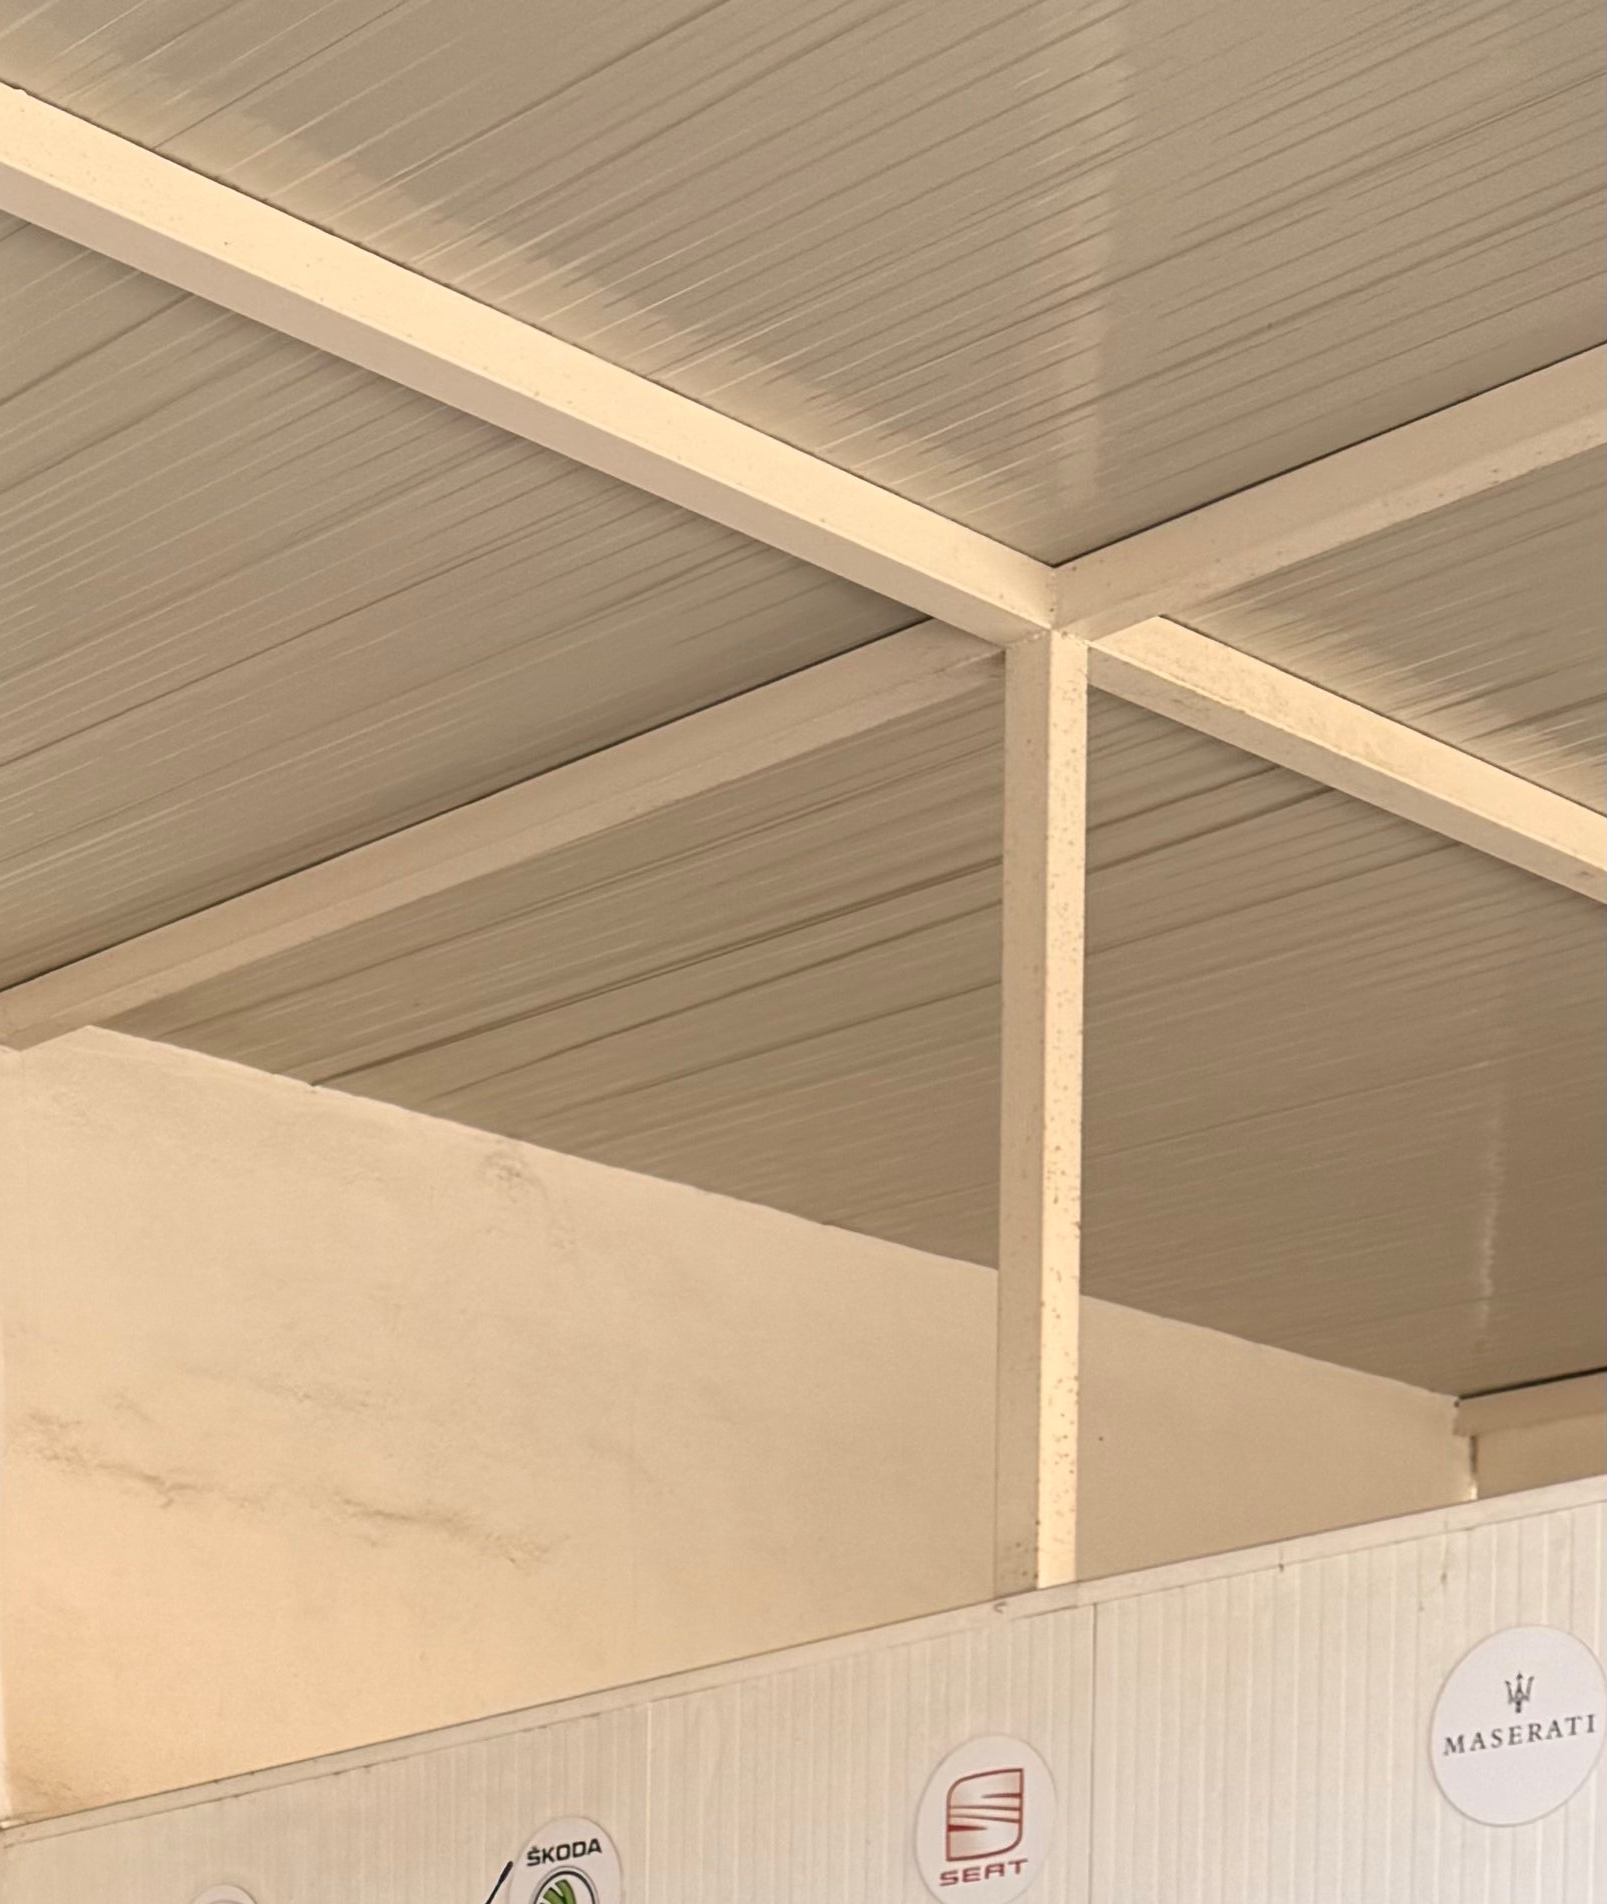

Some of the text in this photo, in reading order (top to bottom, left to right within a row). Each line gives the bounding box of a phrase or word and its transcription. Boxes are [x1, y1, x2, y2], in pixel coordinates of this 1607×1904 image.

[1443, 1714, 1596, 1756] MASERATI
[526, 1837, 602, 1867] ŠKODA
[939, 1858, 1028, 1886] SEAT
